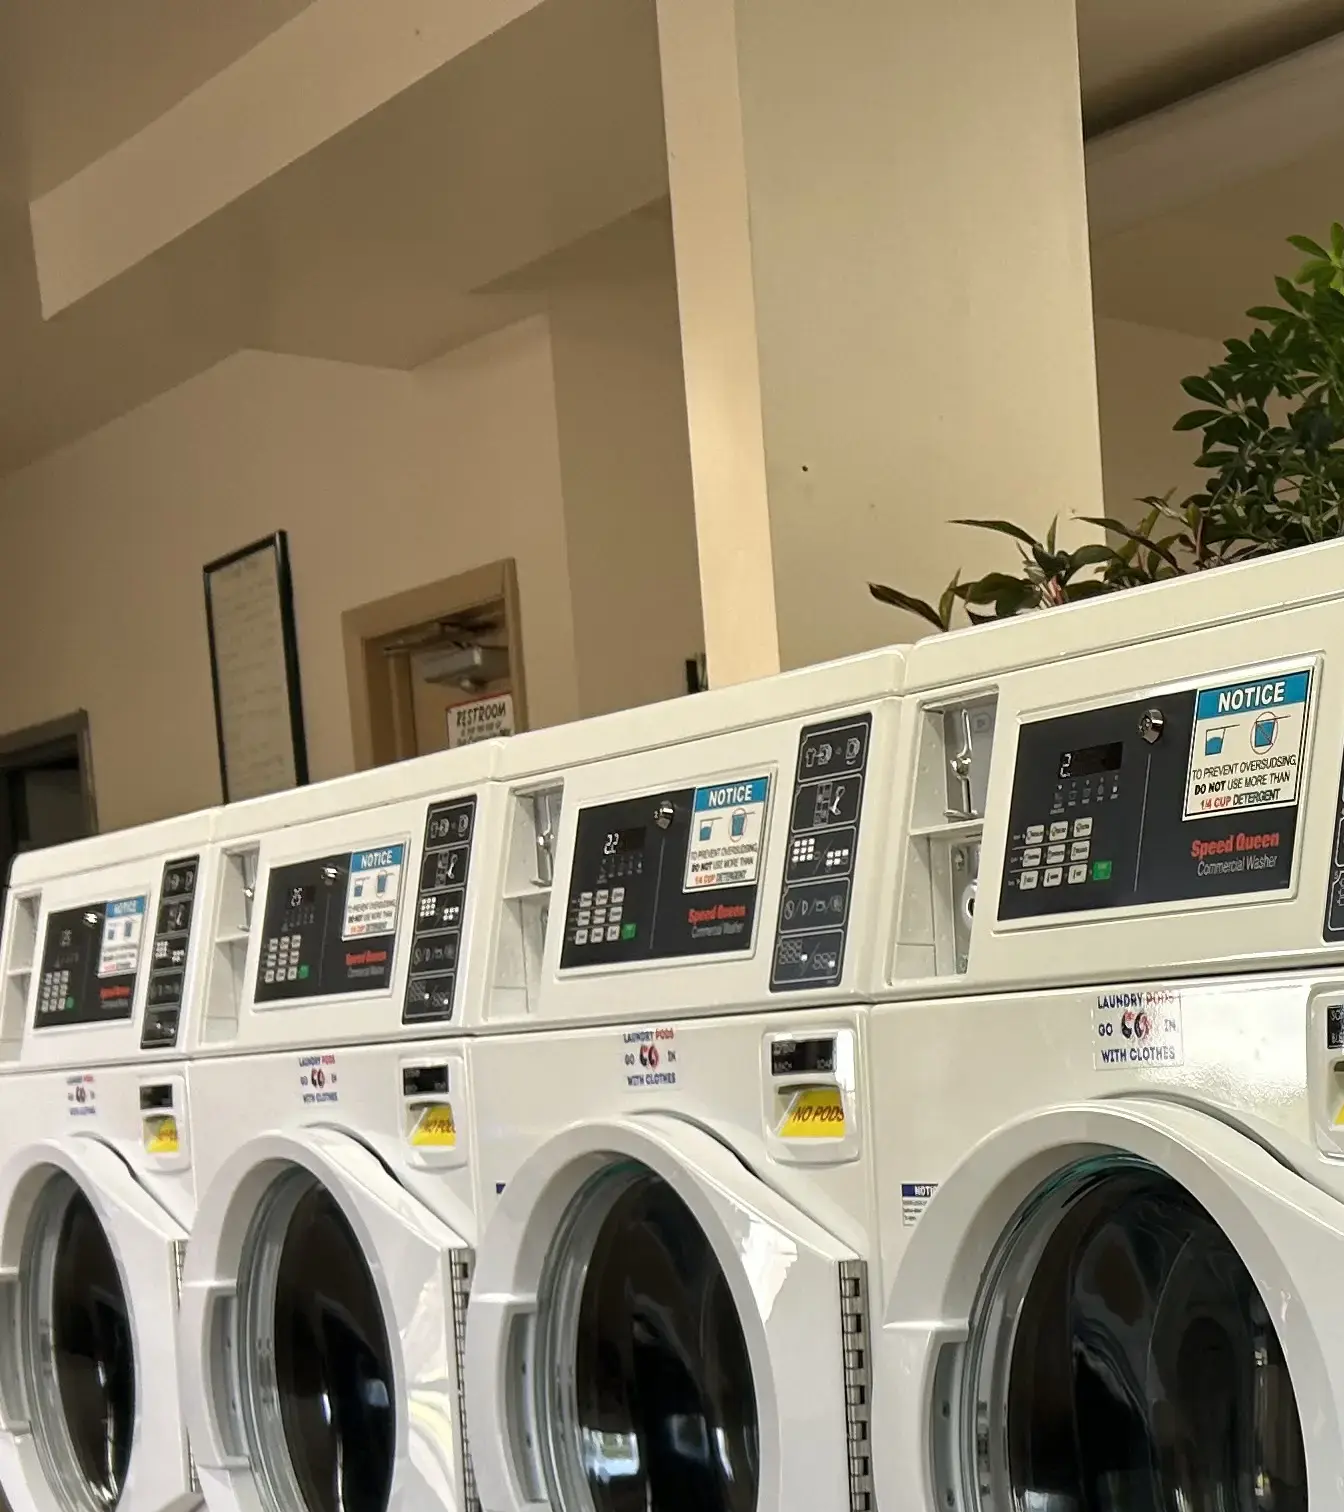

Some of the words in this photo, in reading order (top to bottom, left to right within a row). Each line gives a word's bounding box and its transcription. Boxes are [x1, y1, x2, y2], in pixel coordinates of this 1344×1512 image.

[1218, 681, 1285, 713] NOTICE
[457, 702, 506, 728] RESTROOM
[1192, 769, 1202, 780] TO
[1203, 763, 1239, 777] PREVENT
[1194, 784, 1206, 795] DO
[1208, 780, 1226, 793] NOT
[1227, 778, 1242, 790] USE
[1244, 774, 1268, 787] MORE
[1269, 770, 1290, 784] THAN
[708, 784, 753, 807] NOTICE
[1214, 796, 1232, 807] CUP
[1233, 788, 1281, 806] DETERGENT
[1191, 835, 1233, 860] Speed
[1236, 832, 1280, 851] Queen
[361, 850, 393, 869] NOTICE
[1197, 856, 1246, 877] Commercial
[1246, 853, 1278, 870] Washer
[1097, 993, 1144, 1009] LAUNDRY
[1098, 1023, 1113, 1036] GO
[1101, 1049, 1127, 1063] WITH
[1130, 1046, 1175, 1061] CLOTHES
[792, 1106, 812, 1122] NO
[812, 1105, 844, 1122] PODS
